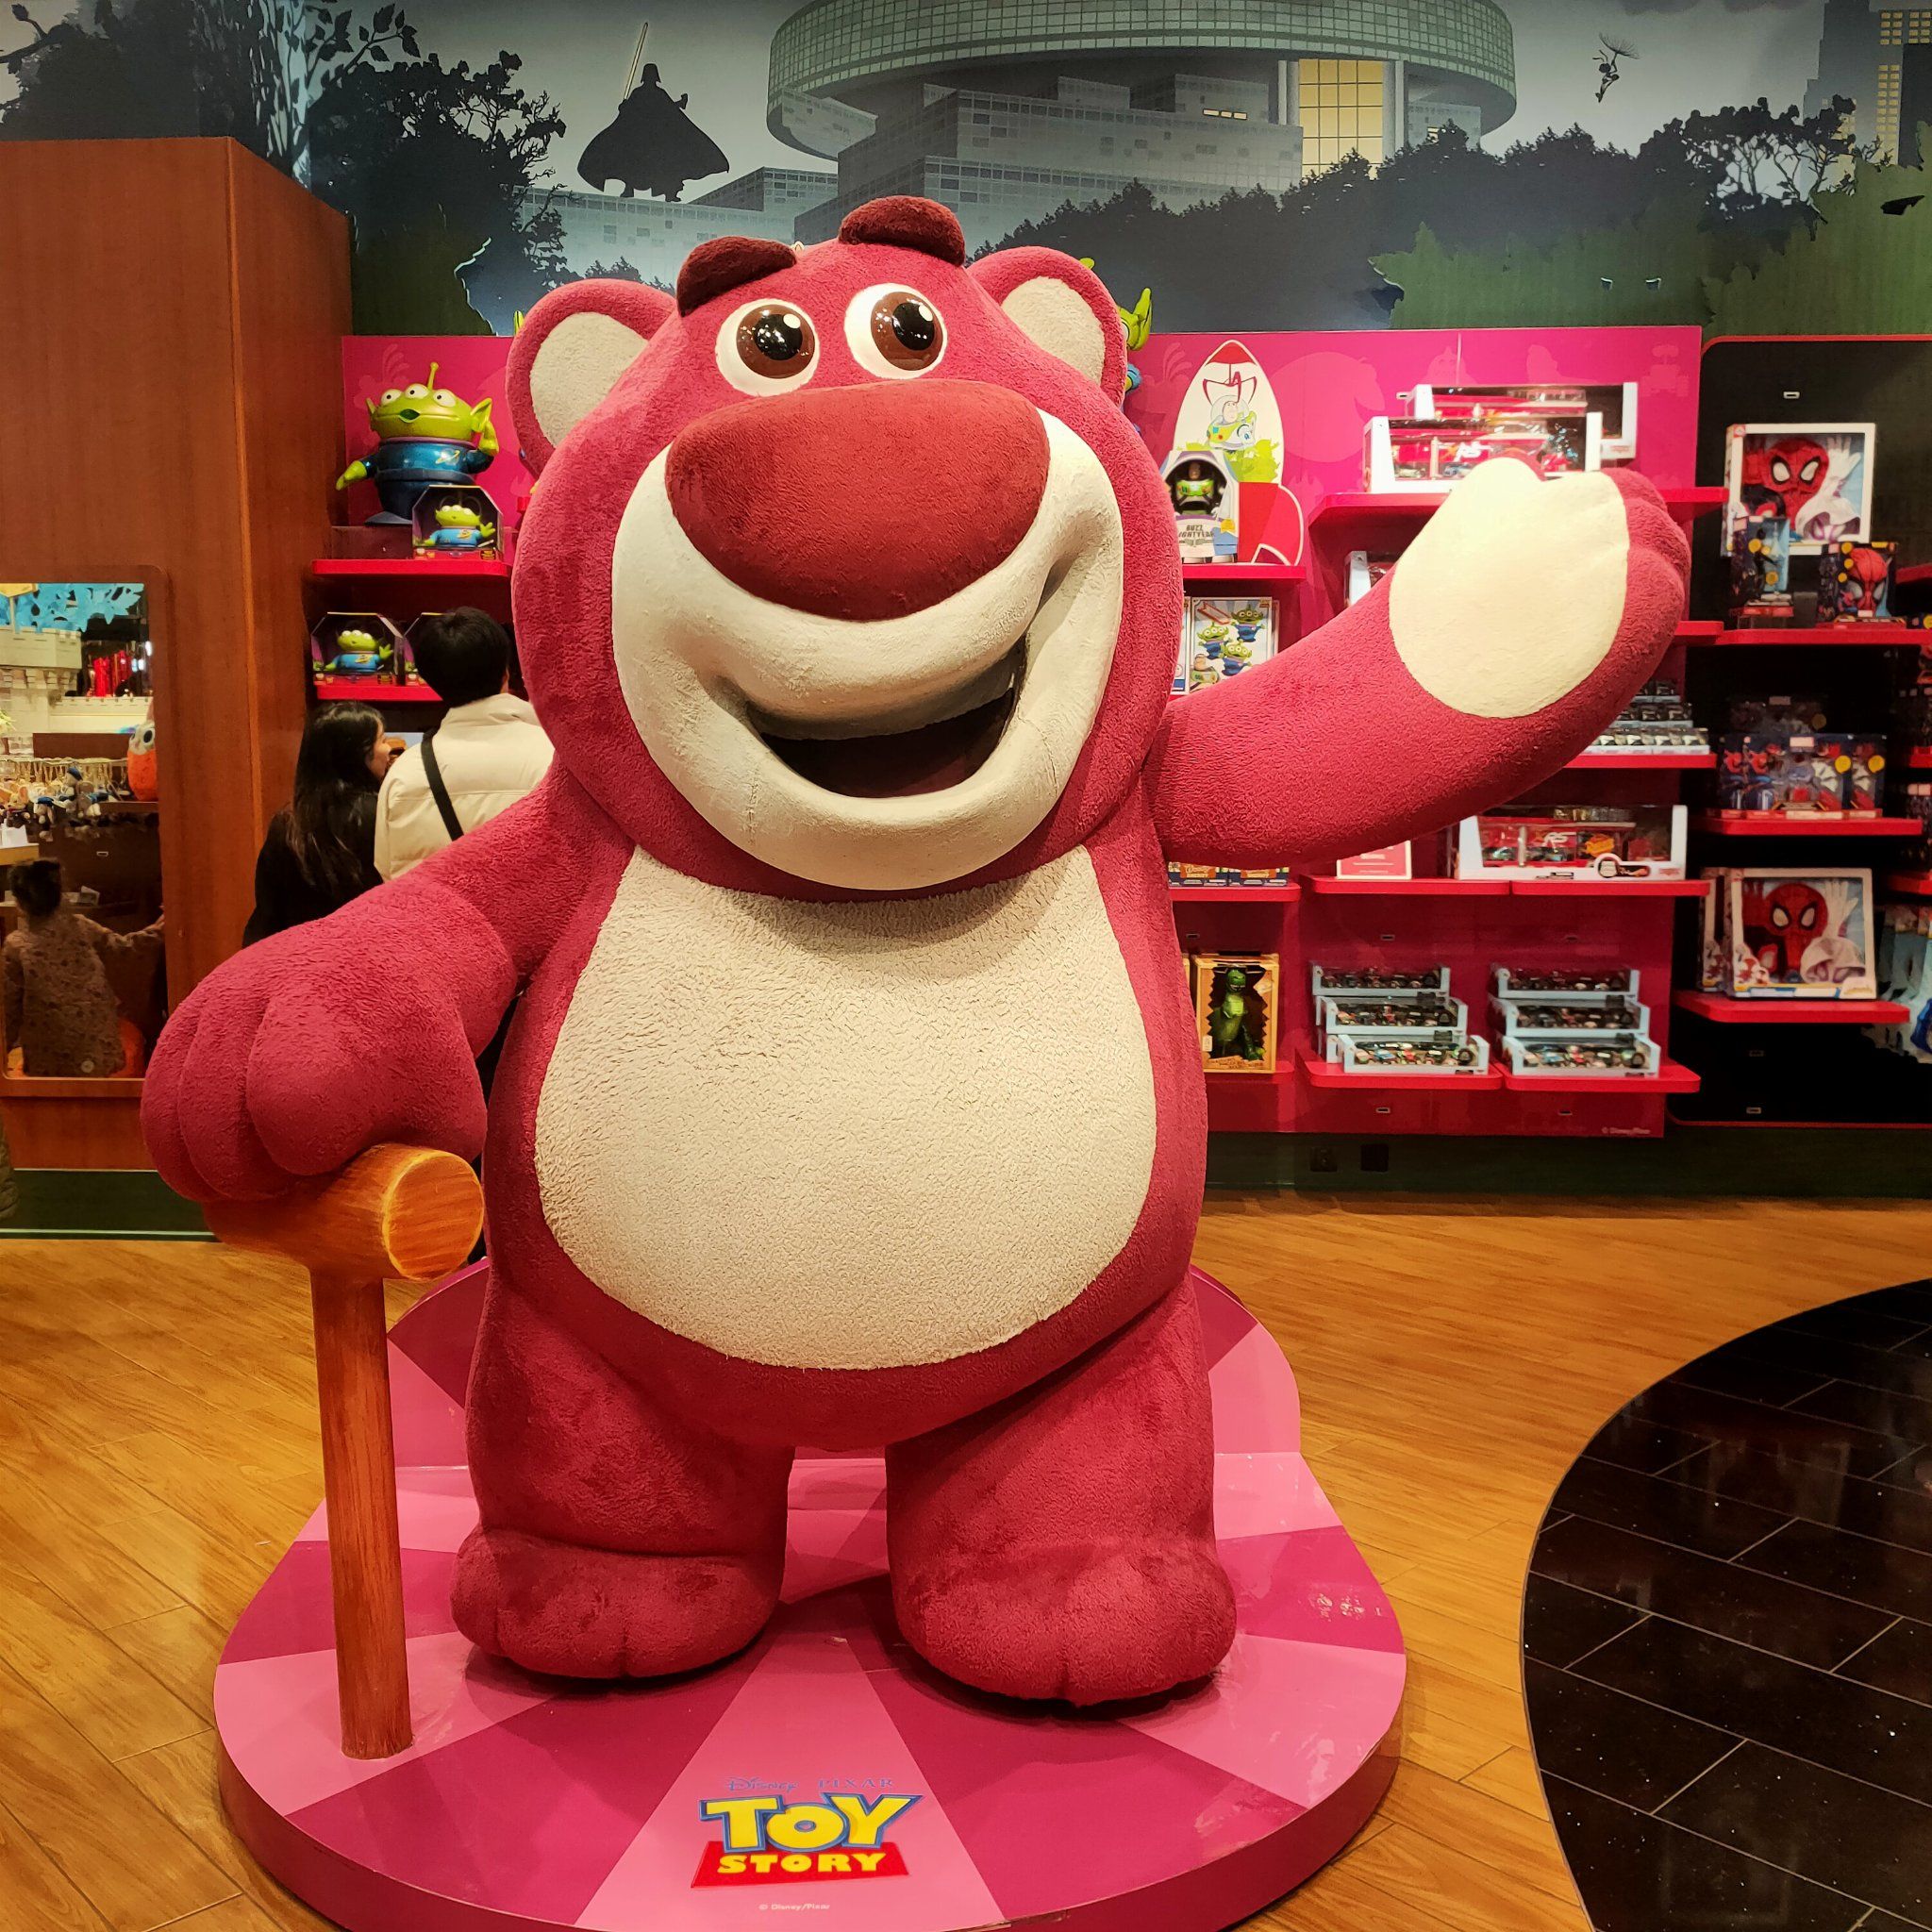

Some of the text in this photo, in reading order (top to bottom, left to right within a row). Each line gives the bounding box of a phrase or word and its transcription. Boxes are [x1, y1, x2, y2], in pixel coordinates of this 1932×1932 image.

[726, 1777, 892, 1792] Disney PIXAR
[699, 1792, 924, 1853] TOY
[717, 1853, 887, 1874] STORY
[771, 1903, 831, 1911] Disney/Pixar
